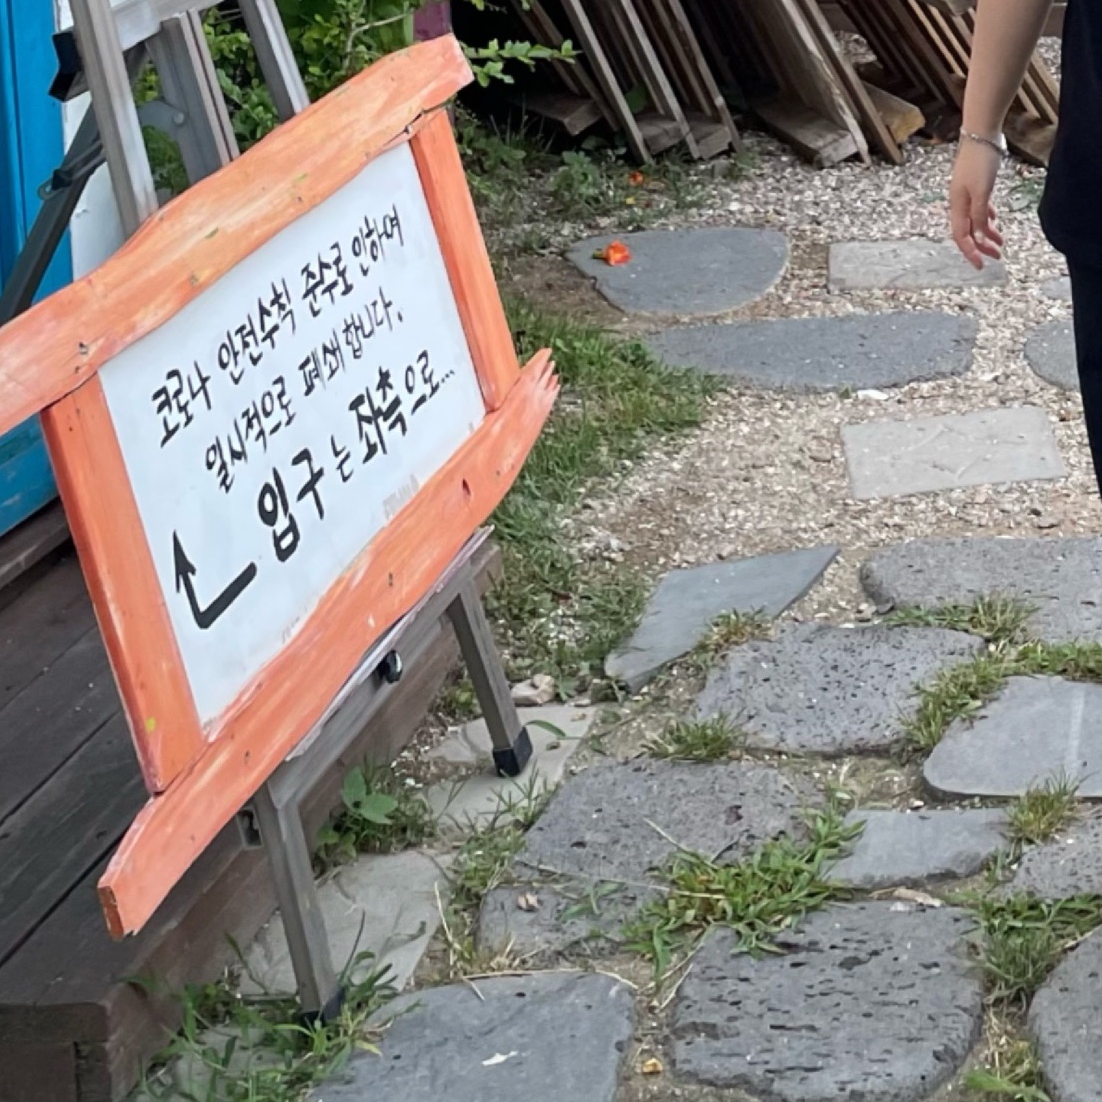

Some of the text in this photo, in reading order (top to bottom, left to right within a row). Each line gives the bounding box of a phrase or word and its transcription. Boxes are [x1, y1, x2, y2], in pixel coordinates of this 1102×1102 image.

[152, 204, 404, 448] 코로나 안전수칙 준수로 인하여
[205, 286, 404, 495] 일시적으로 폐쇄합니다.
